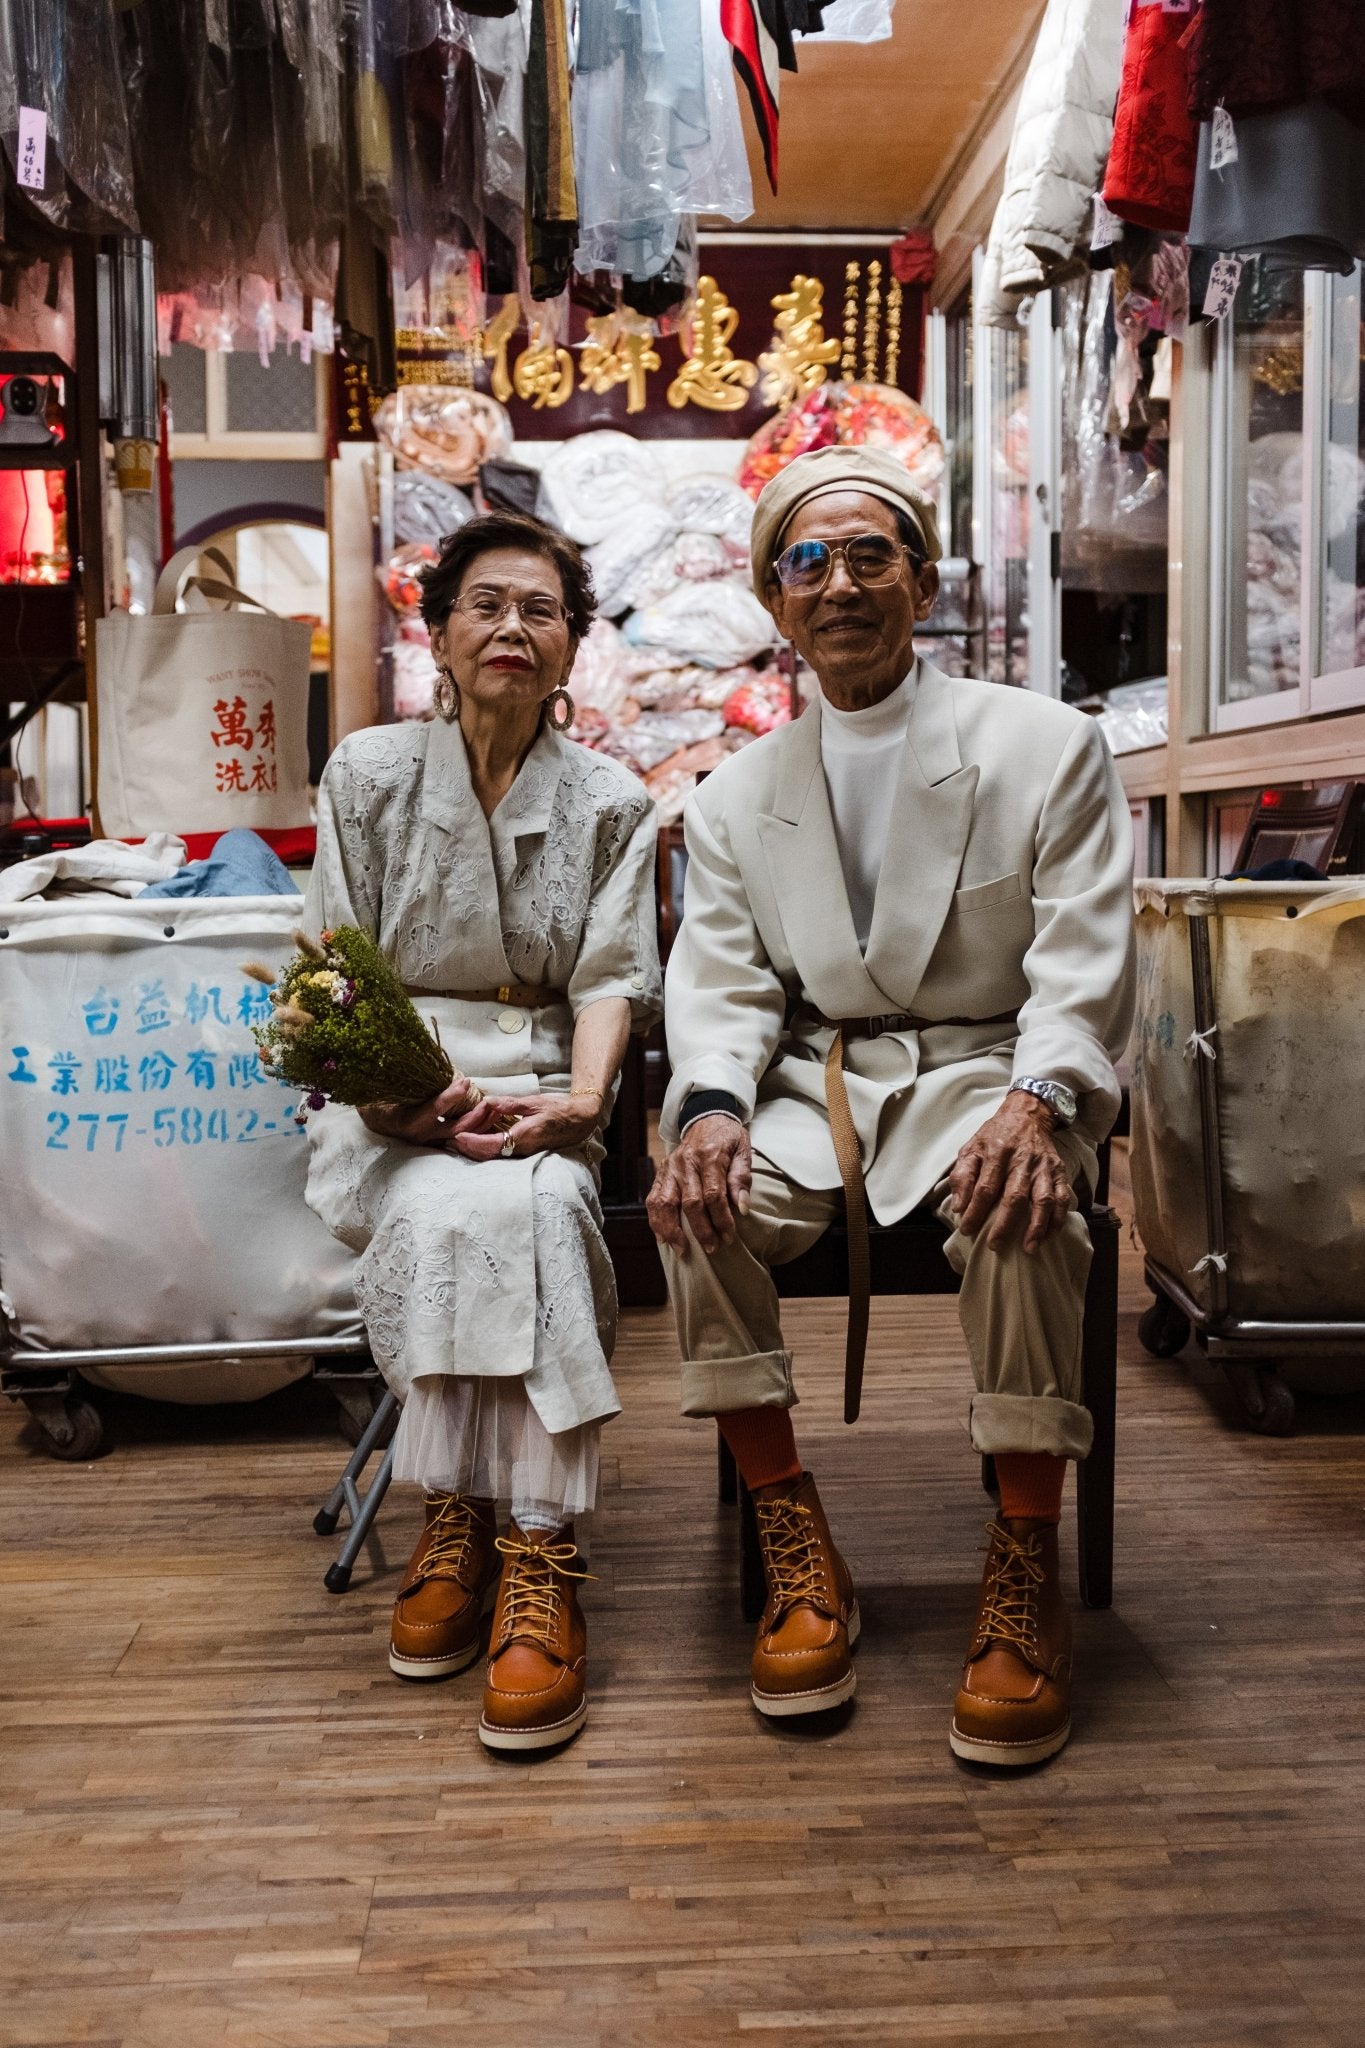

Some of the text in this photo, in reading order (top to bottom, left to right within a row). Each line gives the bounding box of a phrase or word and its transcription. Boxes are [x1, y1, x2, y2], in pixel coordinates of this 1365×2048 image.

[211, 695, 276, 755] 萬秀
[215, 755, 277, 793] 洗衣
[8, 1046, 290, 1096] 工業股份有限
